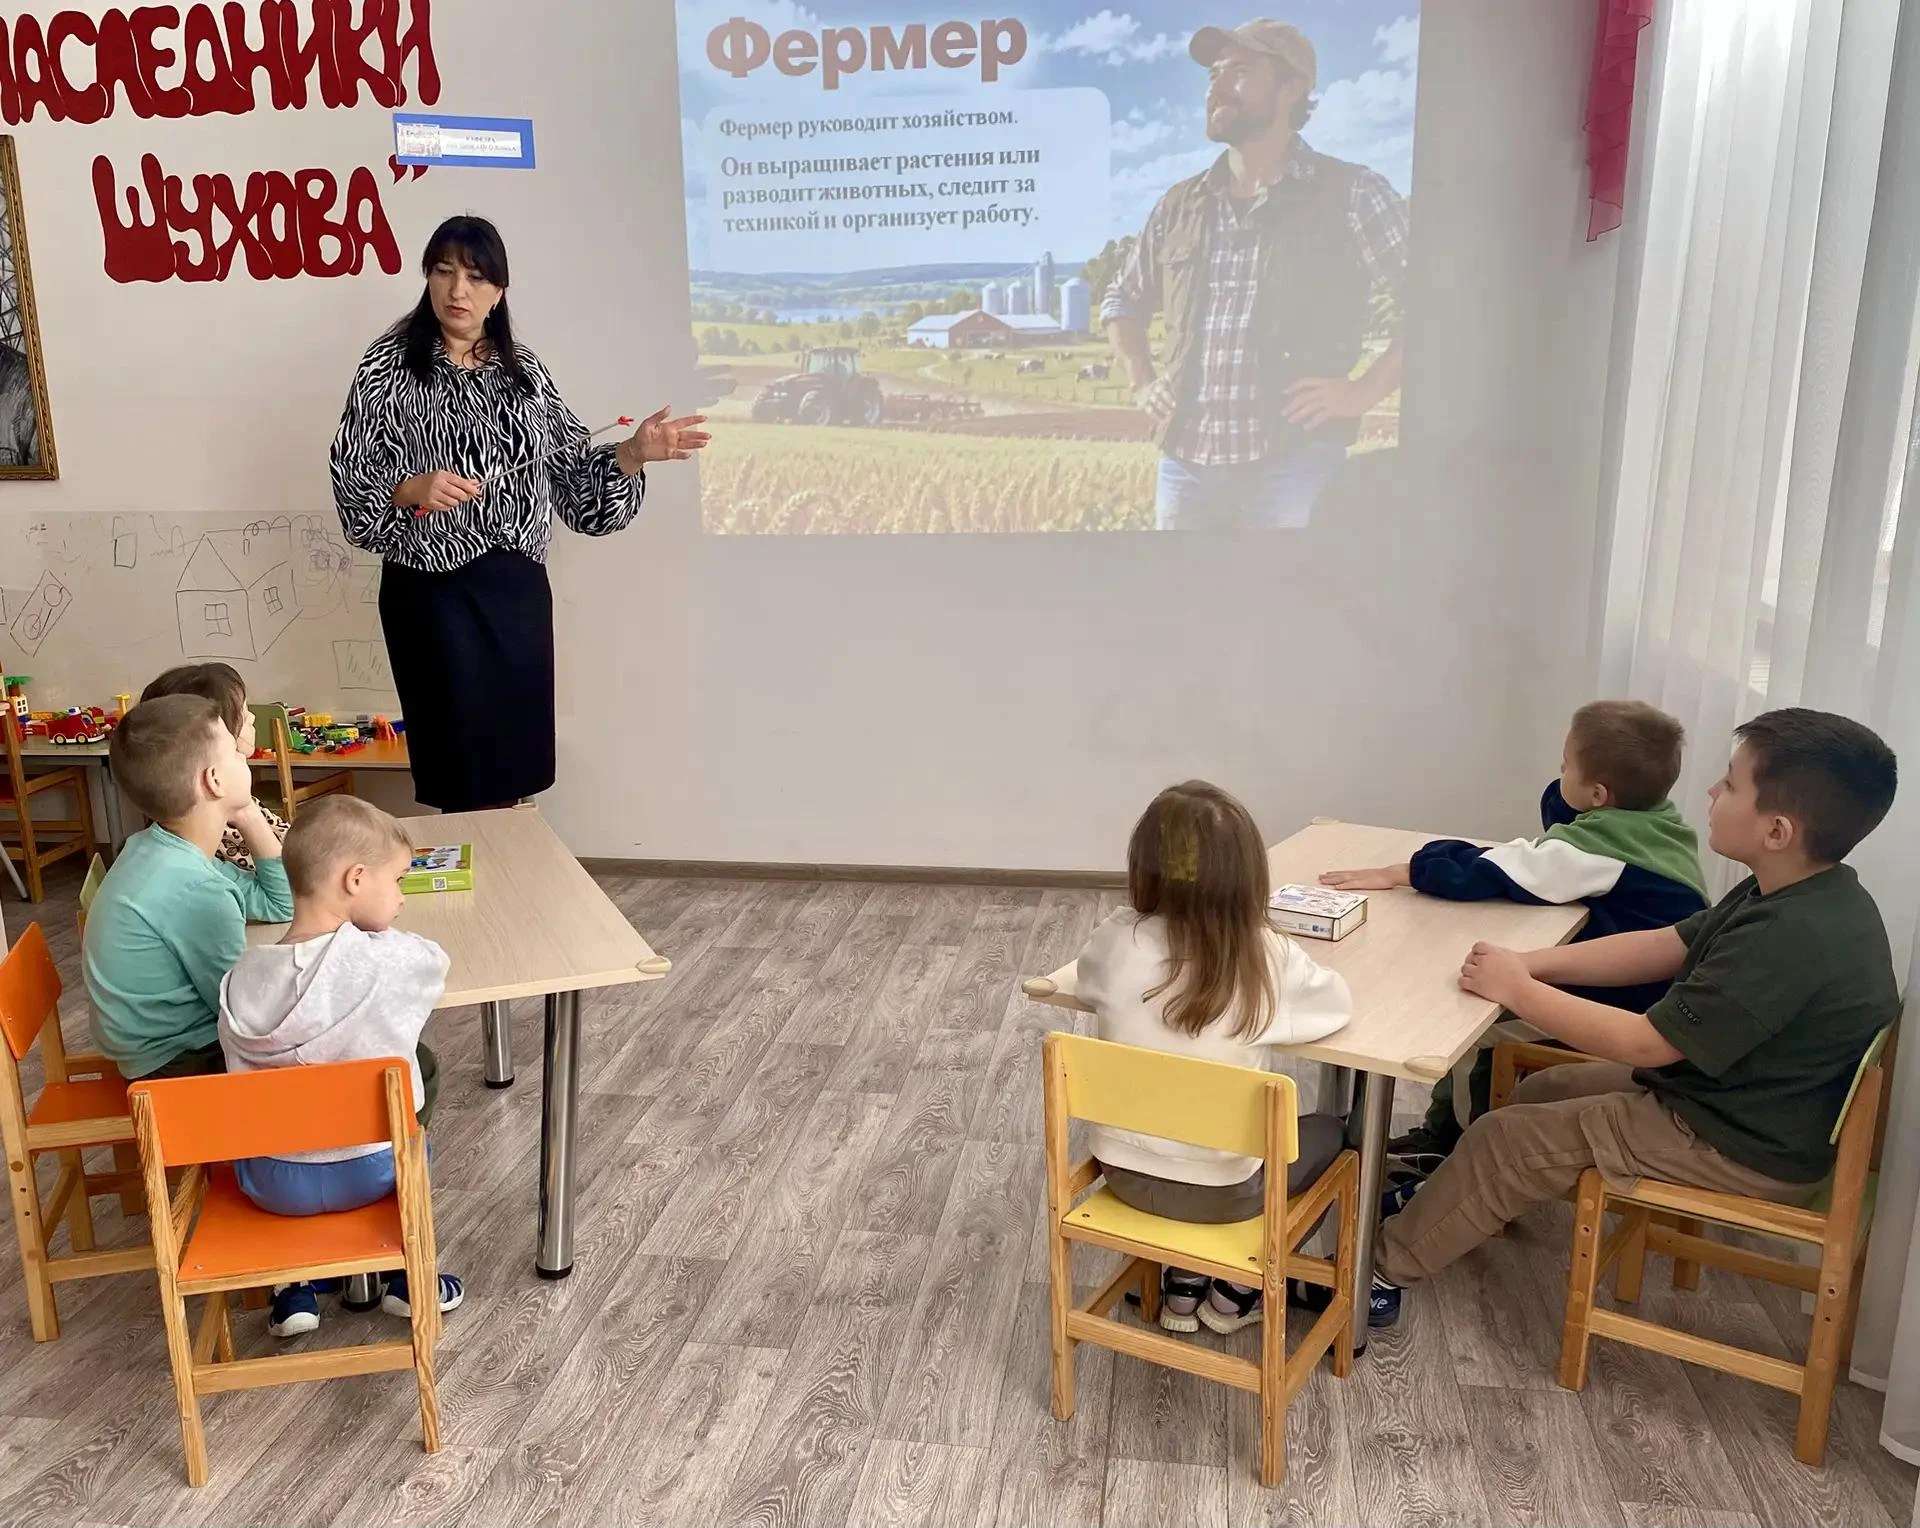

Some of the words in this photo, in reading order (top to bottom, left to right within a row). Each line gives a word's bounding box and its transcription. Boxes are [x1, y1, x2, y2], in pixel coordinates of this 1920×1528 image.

[706, 17, 1027, 90] Фермер
[719, 118, 793, 140] Фермер
[798, 114, 899, 139] руководит
[902, 109, 1018, 130] хозяйством.
[721, 156, 753, 178] Он
[757, 152, 892, 179] выращивает
[896, 149, 994, 175] растения
[999, 147, 1040, 166] или
[722, 186, 817, 210] разводит
[818, 180, 934, 202] животных,
[937, 177, 1009, 197] следит
[1013, 177, 1036, 194] за
[723, 210, 820, 233] техникой
[824, 214, 838, 229] и
[843, 209, 959, 234] организует
[962, 203, 1039, 230] работу.
